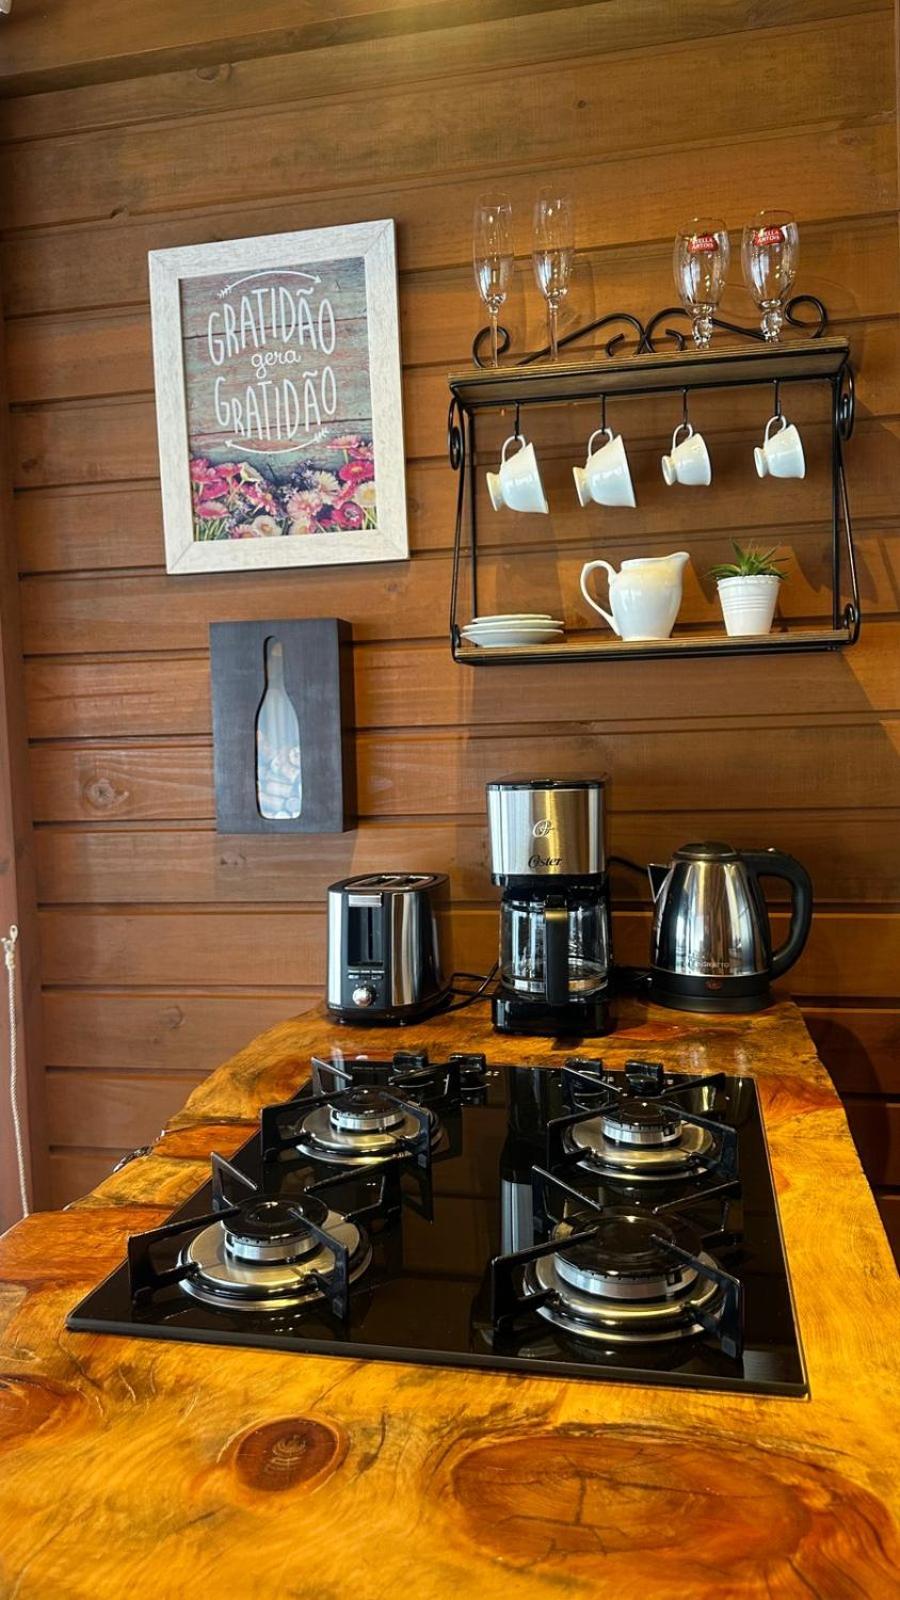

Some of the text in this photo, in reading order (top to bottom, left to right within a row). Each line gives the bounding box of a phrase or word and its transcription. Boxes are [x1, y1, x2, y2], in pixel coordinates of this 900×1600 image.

[207, 286, 336, 366] GRATIDÃO
[251, 350, 301, 380] gera
[214, 365, 337, 441] GRATIDÃO
[528, 854, 562, 869] Oster
